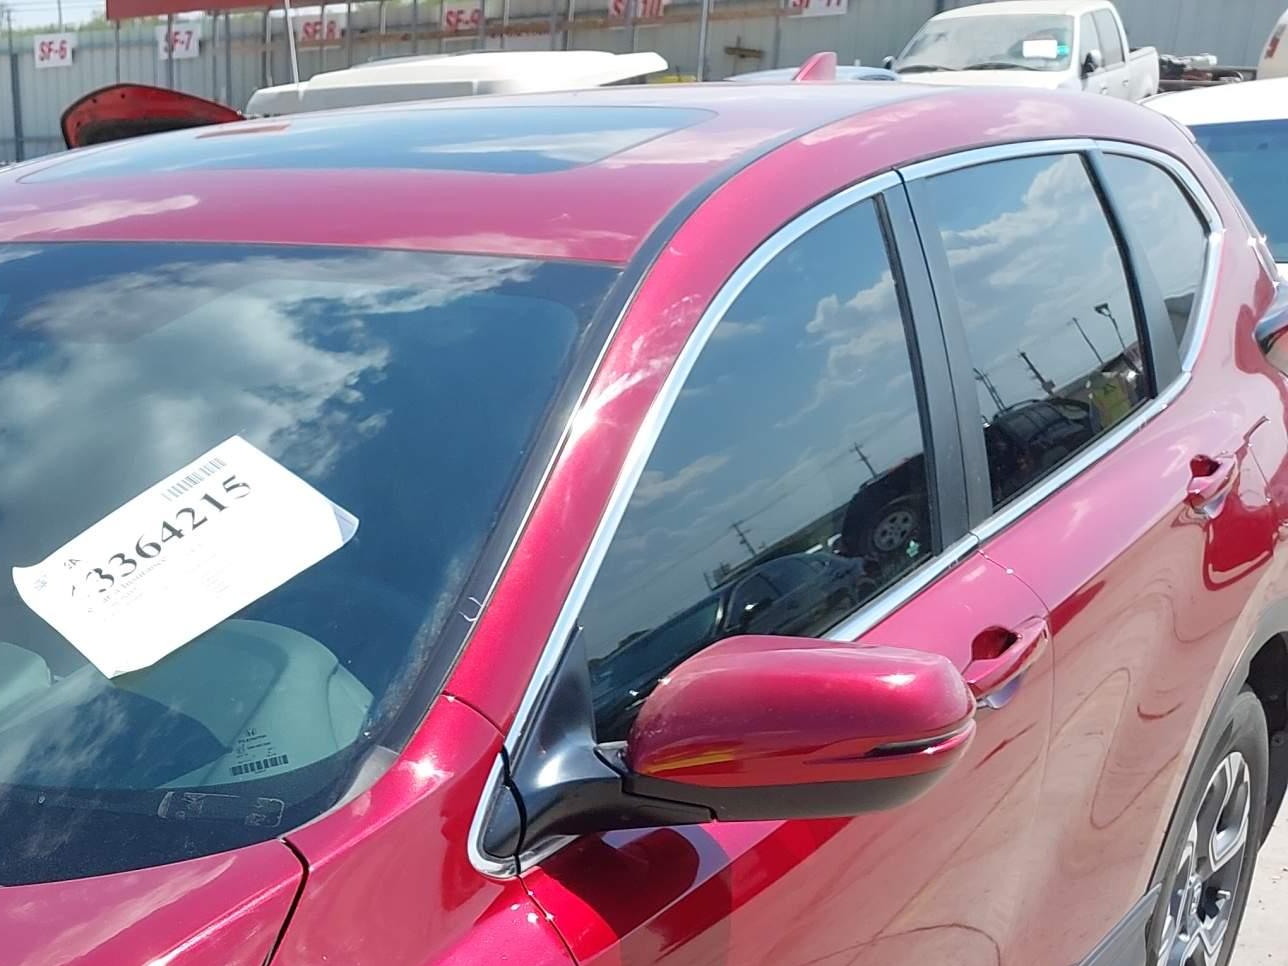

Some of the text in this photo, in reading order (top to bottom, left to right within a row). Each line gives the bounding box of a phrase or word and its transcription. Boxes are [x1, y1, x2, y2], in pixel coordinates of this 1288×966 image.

[303, 20, 336, 41] SF8
[39, 40, 68, 62] SF-6
[72, 475, 252, 598] 3364215
